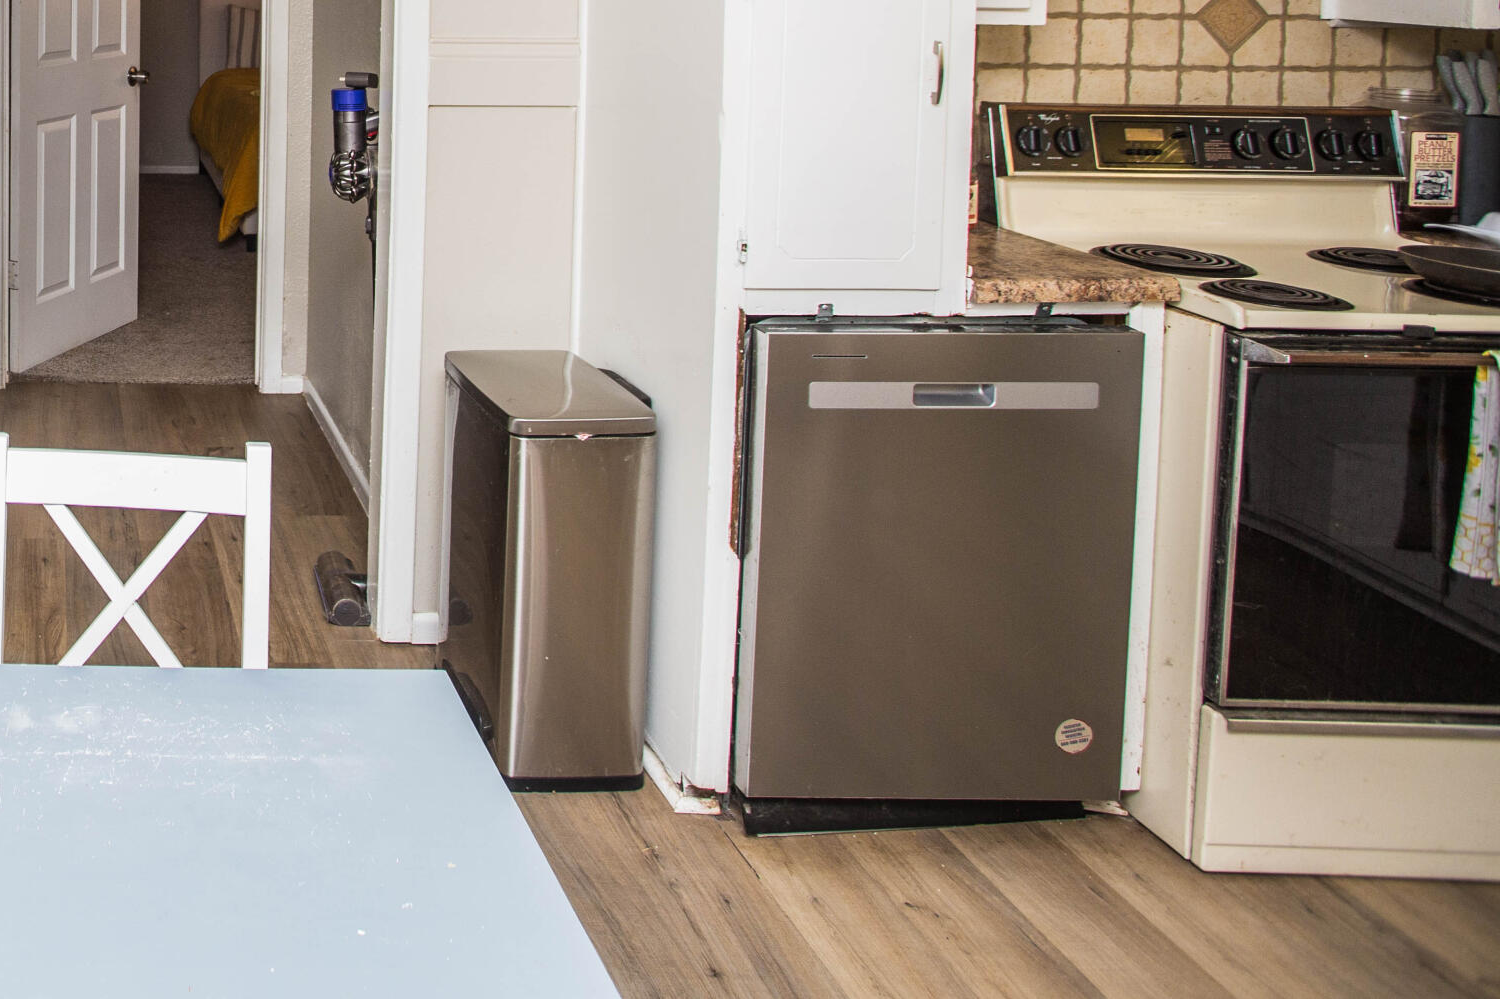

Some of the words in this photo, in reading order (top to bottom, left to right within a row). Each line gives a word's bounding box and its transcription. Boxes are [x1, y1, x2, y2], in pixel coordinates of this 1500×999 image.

[1418, 140, 1453, 148] PEANUT
[1418, 147, 1453, 155] BUTTER
[1414, 154, 1456, 162] PRETZELS
